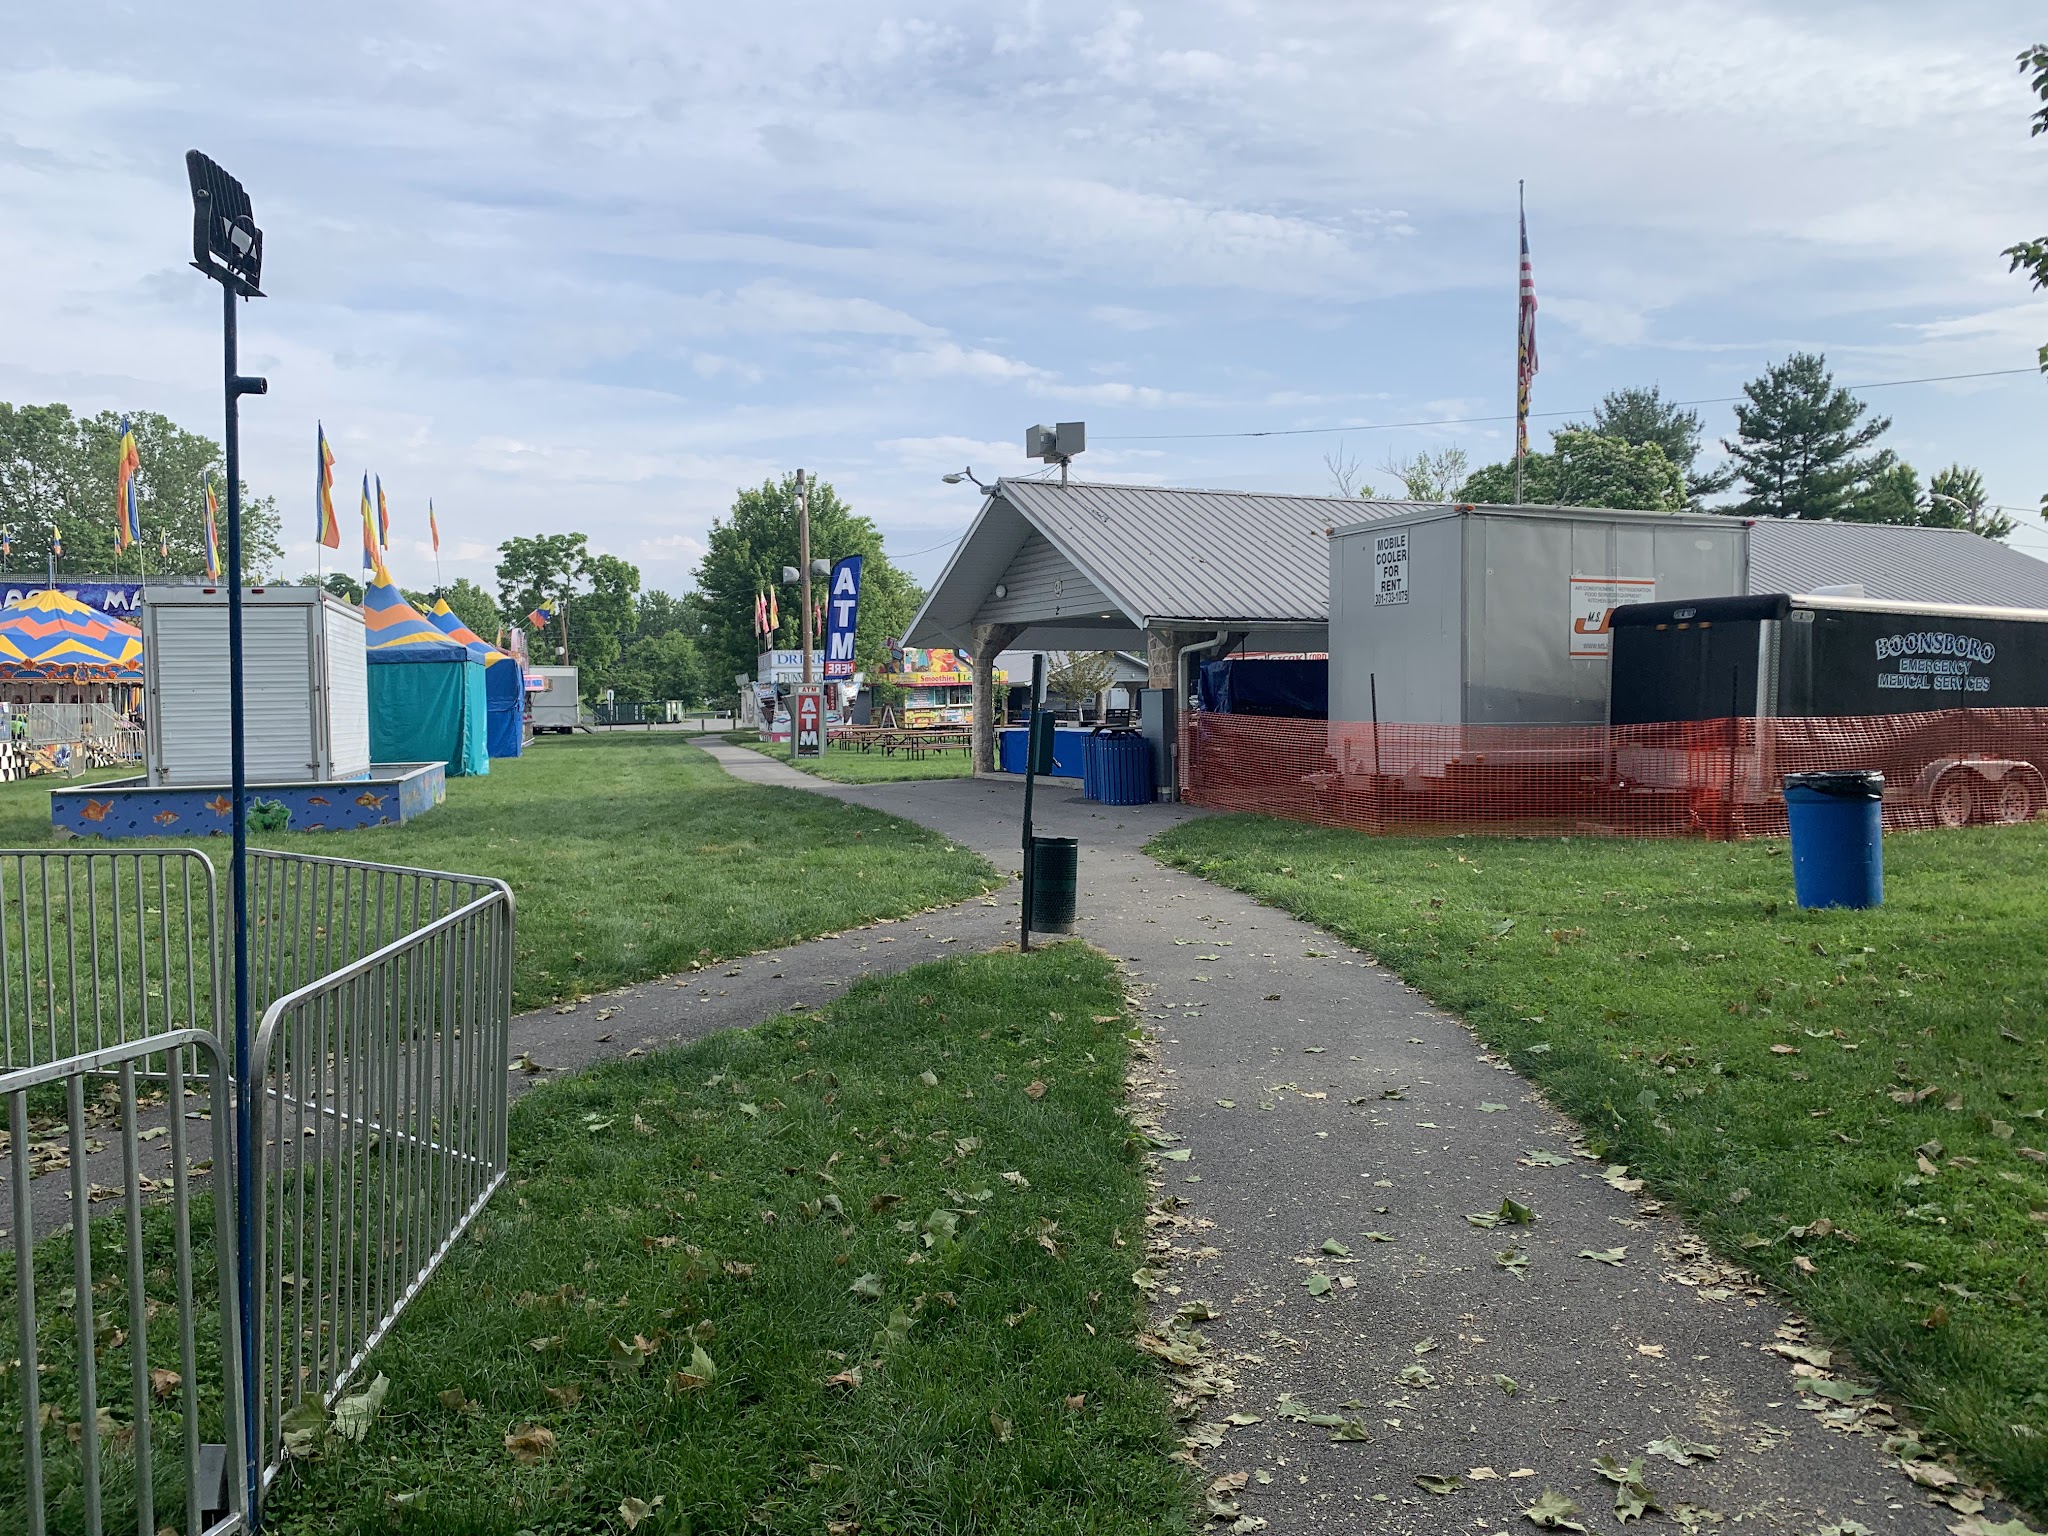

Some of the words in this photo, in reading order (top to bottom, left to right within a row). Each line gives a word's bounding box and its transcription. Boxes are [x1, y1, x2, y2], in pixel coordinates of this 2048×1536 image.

[1377, 535, 1406, 551] MOBILE
[1376, 549, 1407, 565] COOLER
[1383, 565, 1399, 578] FOR
[1381, 578, 1402, 592] RENT
[830, 567, 856, 660] ATM
[1875, 632, 1995, 664] BOONSBORO
[1899, 658, 1972, 675] EMERGENCY
[920, 674, 956, 682] Smoothies
[1878, 673, 1931, 689] MEDICAL
[1934, 674, 1991, 691] SERVICES
[799, 697, 819, 746] ATM
